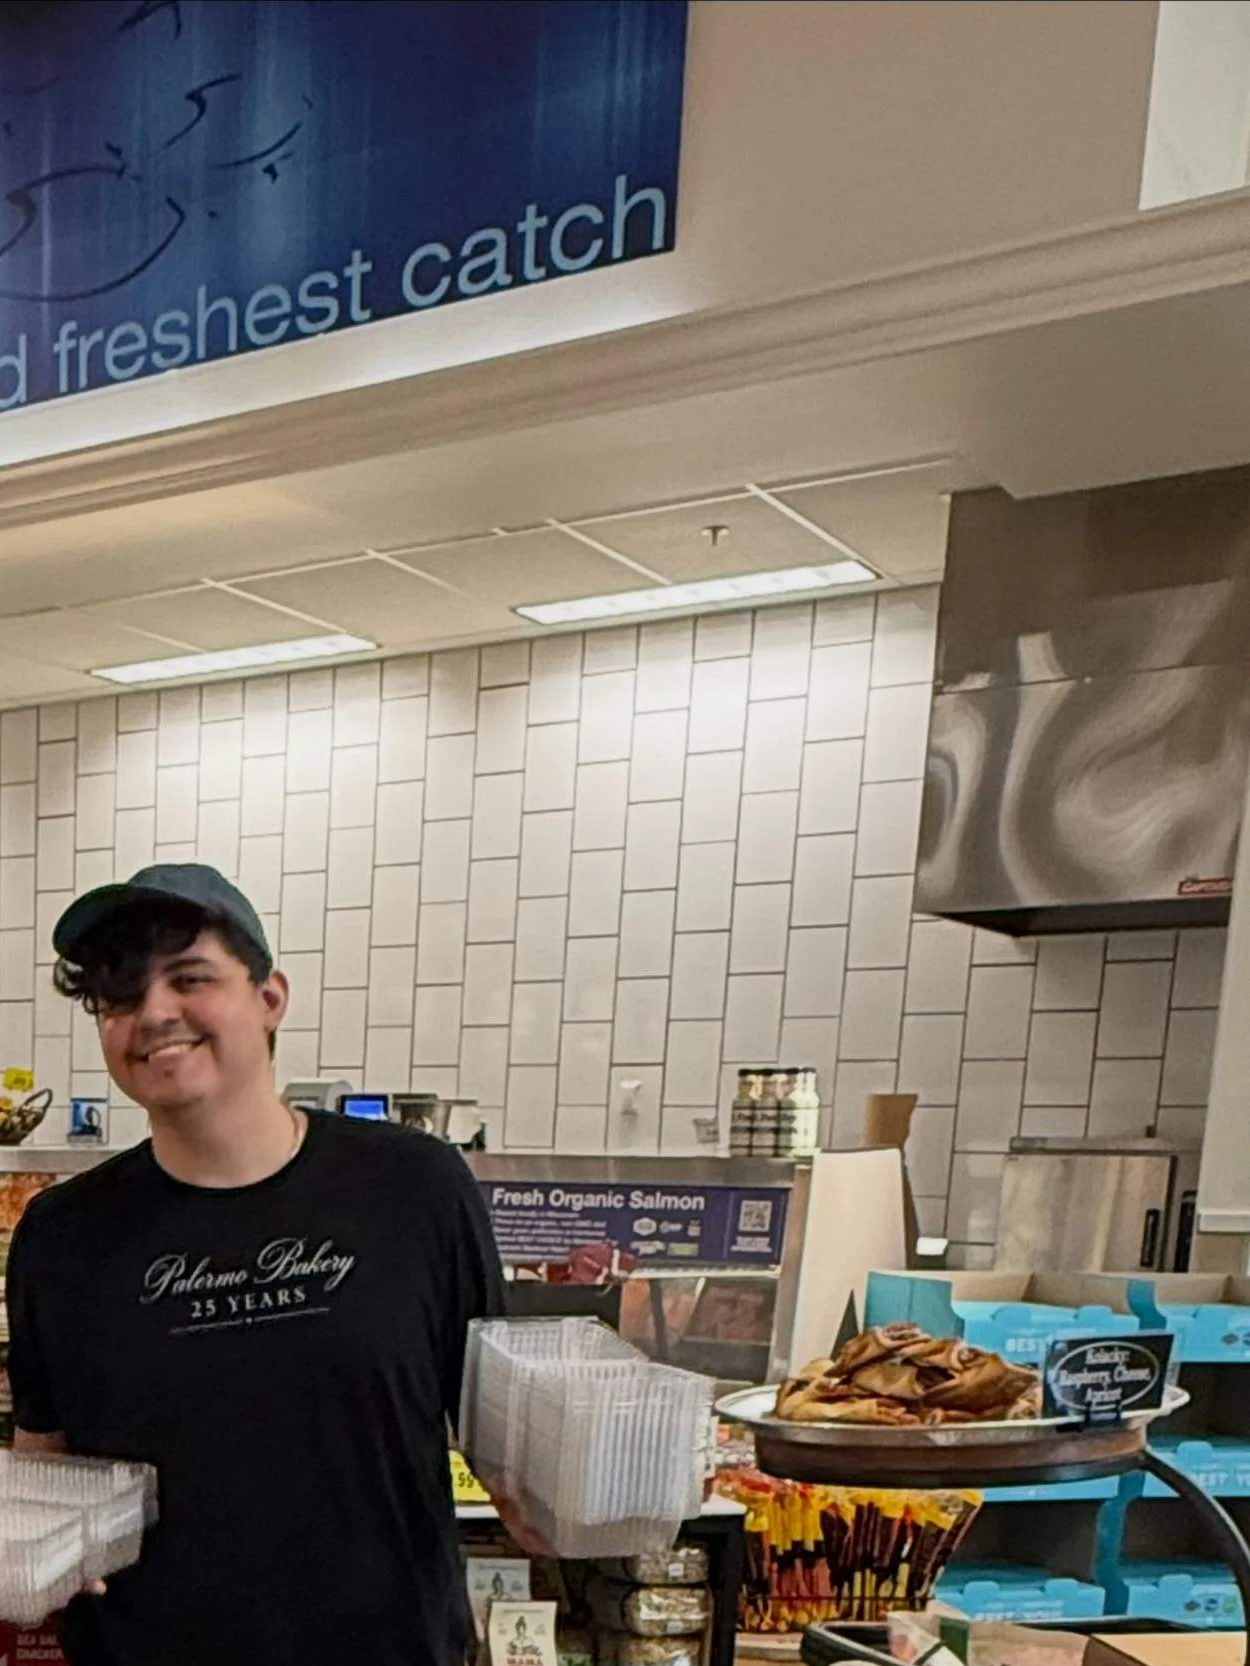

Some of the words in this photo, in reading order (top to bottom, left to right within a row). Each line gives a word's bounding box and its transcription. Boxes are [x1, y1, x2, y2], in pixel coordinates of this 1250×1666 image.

[53, 247, 374, 395] freshest
[401, 173, 669, 310] catch
[491, 1187, 544, 1207] Fresh
[548, 1188, 625, 1212] Organic
[628, 1190, 706, 1211] Salmon
[139, 1252, 249, 1304] Palermo
[253, 1236, 356, 1292] Bakery
[190, 1298, 217, 1319] 25
[227, 1285, 307, 1314] YEARS
